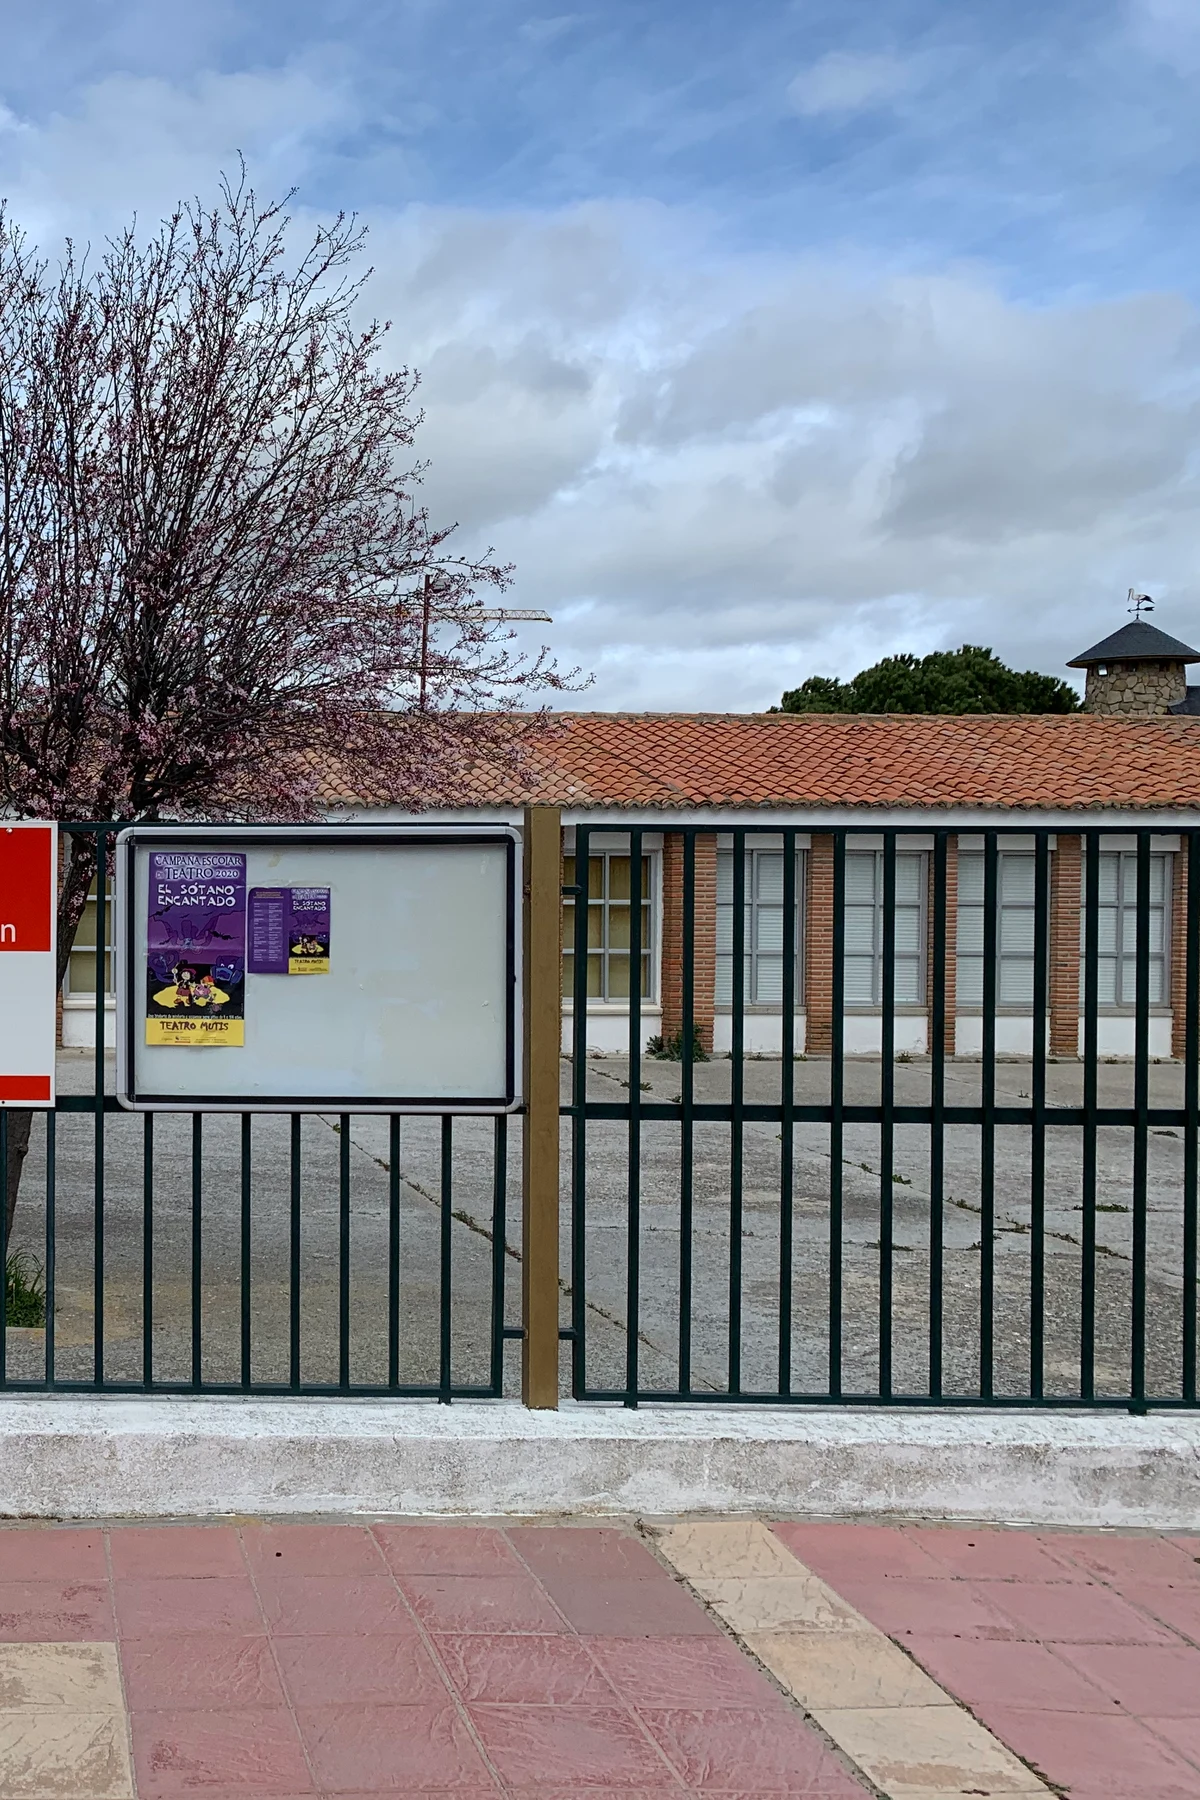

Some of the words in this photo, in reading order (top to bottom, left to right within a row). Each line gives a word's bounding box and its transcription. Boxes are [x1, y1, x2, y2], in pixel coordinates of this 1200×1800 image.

[164, 866, 214, 880] TEATRO
[215, 870, 239, 878] 2020
[158, 884, 172, 894] EL
[180, 882, 235, 895] SÓTANO
[158, 895, 236, 907] ENCANTADO
[160, 1020, 197, 1031] TEATRO
[200, 1021, 229, 1031] MUTIS
